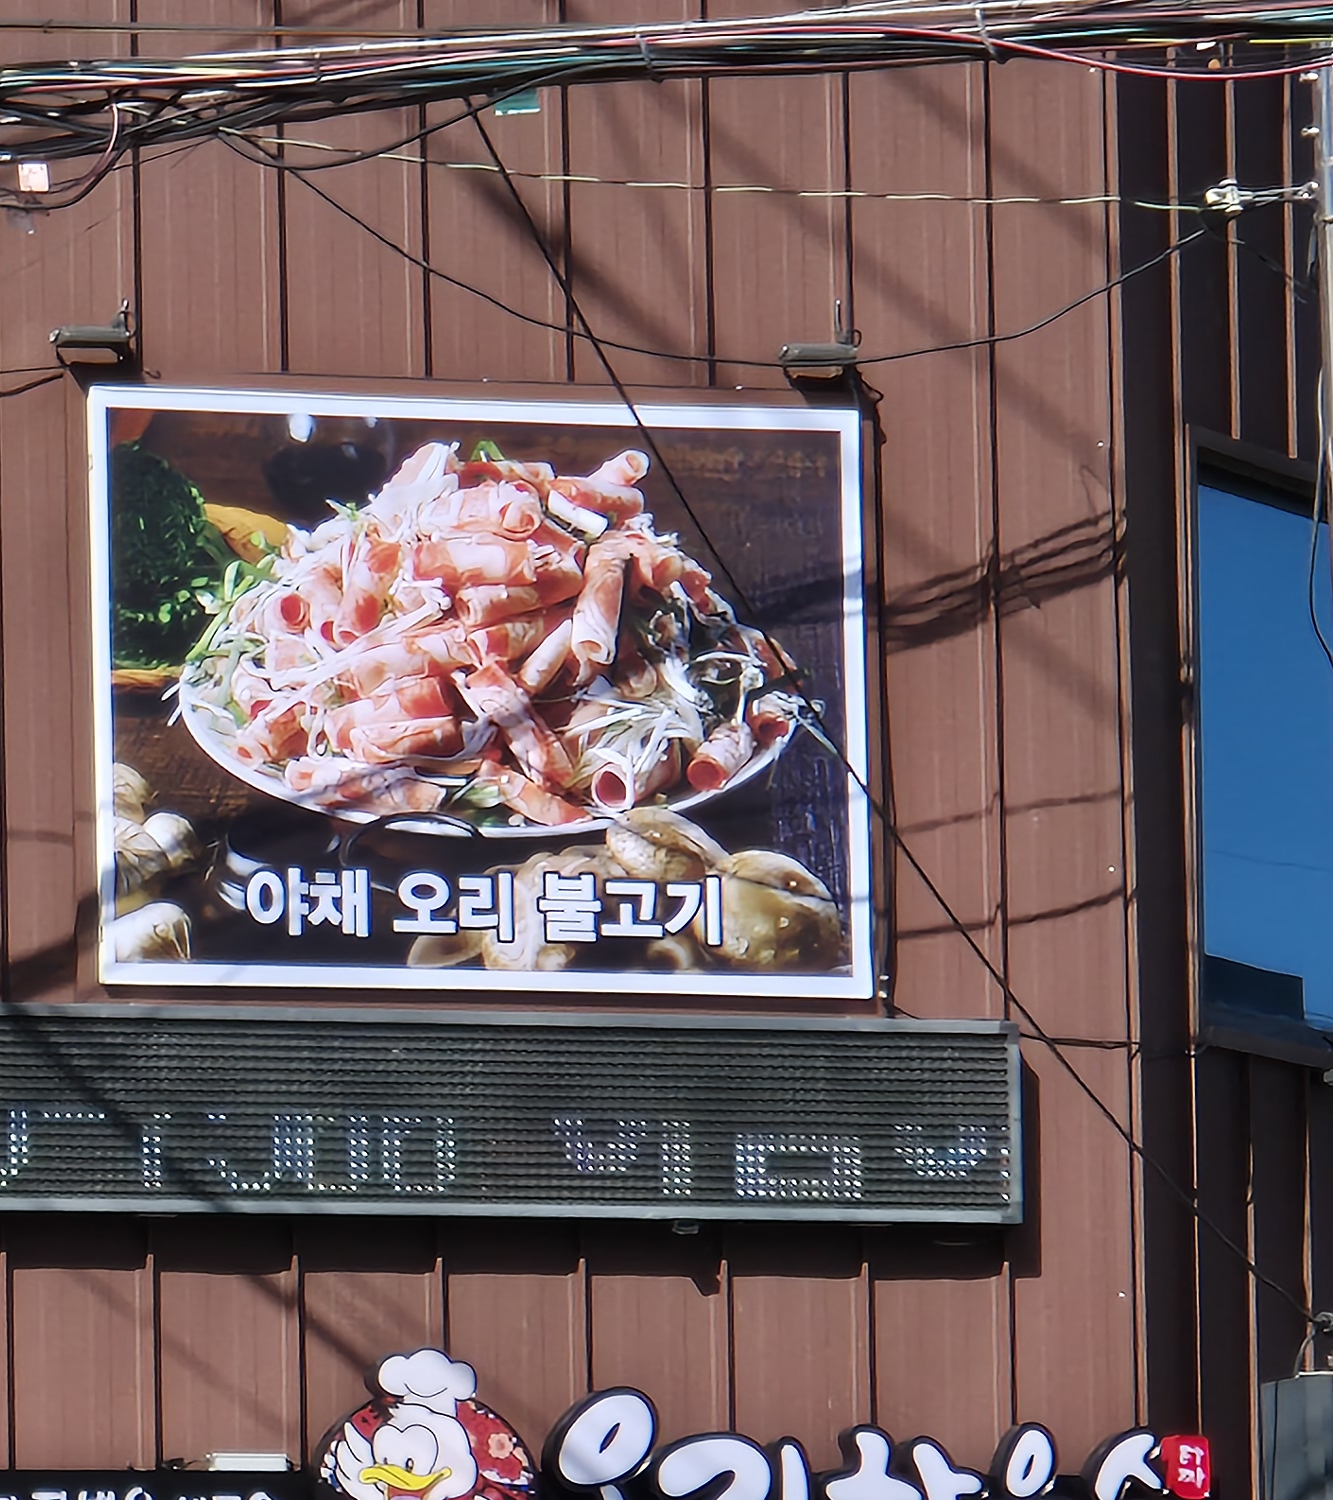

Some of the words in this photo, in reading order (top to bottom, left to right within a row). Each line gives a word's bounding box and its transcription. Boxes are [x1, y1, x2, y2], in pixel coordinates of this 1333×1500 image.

[246, 867, 369, 938] 야채
[394, 872, 515, 942] 오리
[536, 872, 724, 947] 불고기
[1177, 1444, 1206, 1489] 타짜
